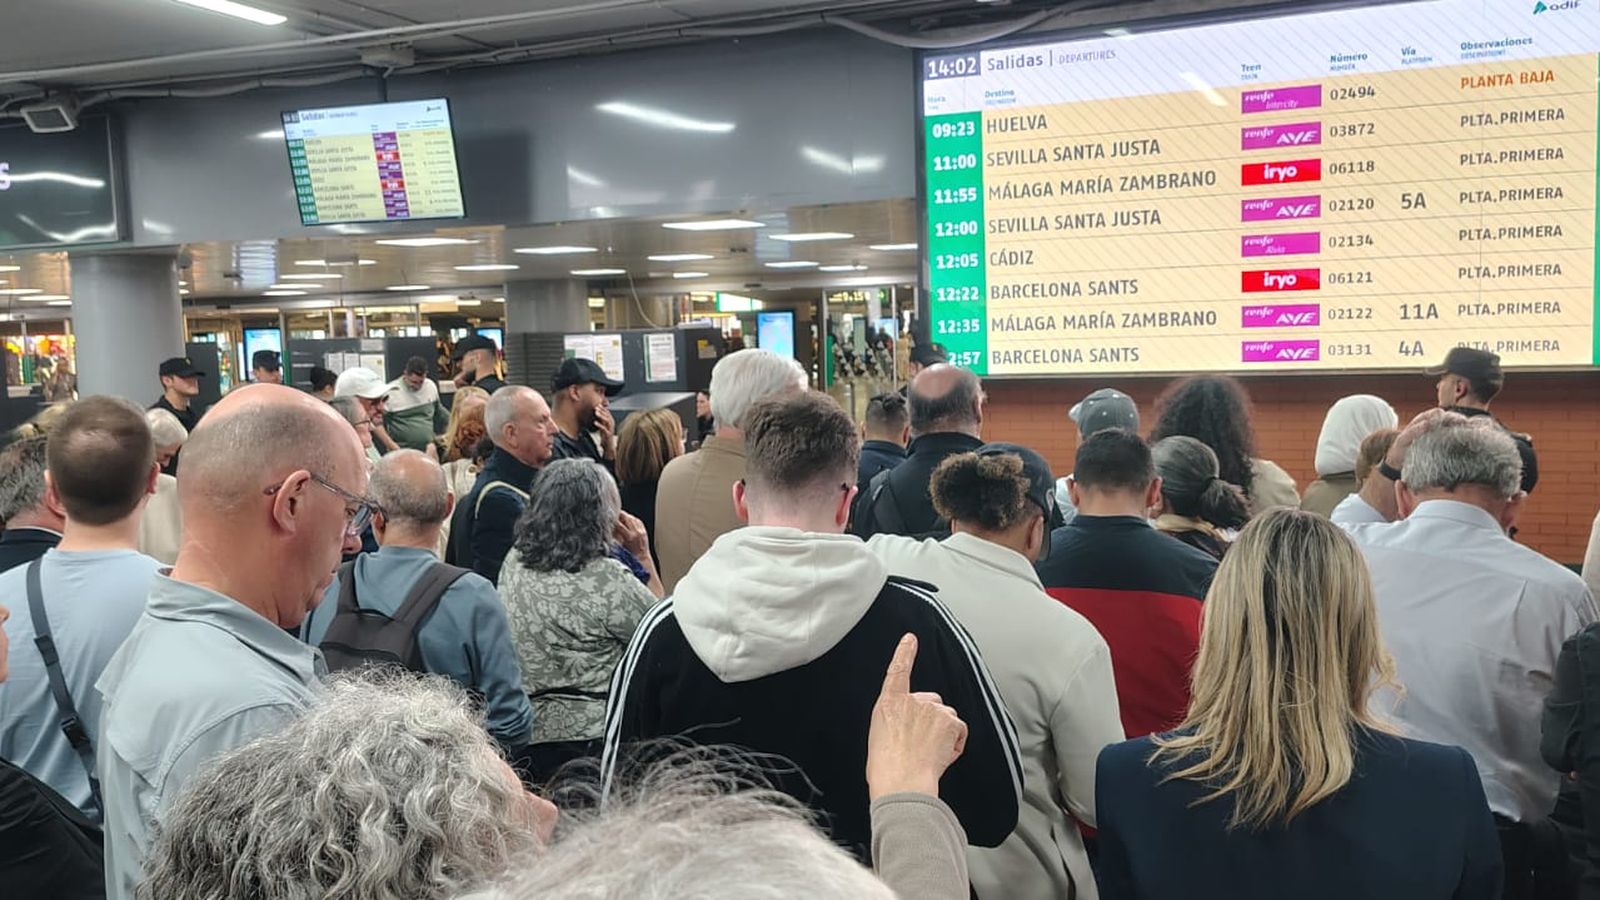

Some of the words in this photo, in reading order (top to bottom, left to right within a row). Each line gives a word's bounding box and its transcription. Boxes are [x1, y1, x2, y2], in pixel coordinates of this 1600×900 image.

[1460, 37, 1533, 50] Observaciones
[987, 54, 1043, 71] Salidas
[1330, 53, 1368, 63] Número
[928, 57, 977, 77] 14:02
[1241, 64, 1262, 73] Tren
[1460, 73, 1514, 90] PLANTA
[1520, 69, 1555, 84] BAJA
[1330, 87, 1376, 101] 02494
[986, 114, 1048, 134] HUELVA
[1460, 107, 1566, 127] PLTA.PRIMERA
[932, 121, 975, 138] 09:23
[1277, 130, 1318, 145] AVE
[1329, 123, 1375, 137] 03872
[986, 148, 1047, 167] SEVILLA
[1053, 143, 1105, 161] SANTA
[1111, 139, 1161, 157] JUSTA
[1460, 148, 1565, 166] PLTA.PRIMERA
[933, 156, 977, 172] 11:00
[1329, 160, 1375, 175] 06118
[1263, 165, 1298, 182] iryo
[988, 178, 1054, 200] MÁLAGA
[1062, 174, 1114, 194] MARÍA
[1119, 170, 1217, 190] ZAMBRANO
[934, 188, 977, 204] 11:55
[1401, 191, 1427, 210] 5A
[1459, 186, 1564, 205] PLTA.PRIMERA
[1276, 203, 1317, 218] AVE
[1329, 198, 1375, 211] 02120
[935, 221, 978, 237] 12:00
[988, 216, 1049, 234] SEVILLA
[1054, 212, 1106, 230] SANTA
[1112, 210, 1162, 227] JUSTA
[1459, 224, 1563, 241] PLTA.PRIMERA
[1328, 234, 1374, 248] 02134
[936, 254, 979, 269] 12:05
[990, 249, 1034, 267] CÁDIZ
[1328, 271, 1374, 285] 06121
[1458, 263, 1562, 279] PLTA.PRIMERA
[1263, 271, 1298, 288] iryo
[936, 286, 979, 301] 12:22
[990, 282, 1082, 300] BARCELONA
[1088, 279, 1139, 296] SANTS
[1328, 308, 1373, 320] 02122
[1400, 303, 1439, 320] 11A
[1458, 301, 1562, 317] PLTA.PRIMERA
[991, 314, 1056, 332] MÁLAGA
[1063, 312, 1115, 330] MARÍA
[1121, 310, 1217, 328] ZAMBRANO
[1276, 311, 1316, 325] AVE
[937, 319, 980, 334] 12:35
[992, 348, 1083, 365] BARCELONA
[1089, 347, 1140, 363] SANTS
[1276, 347, 1316, 361] AVE
[1327, 343, 1373, 356] 03131
[1399, 340, 1424, 356] 4A
[948, 351, 981, 366] 2:57
